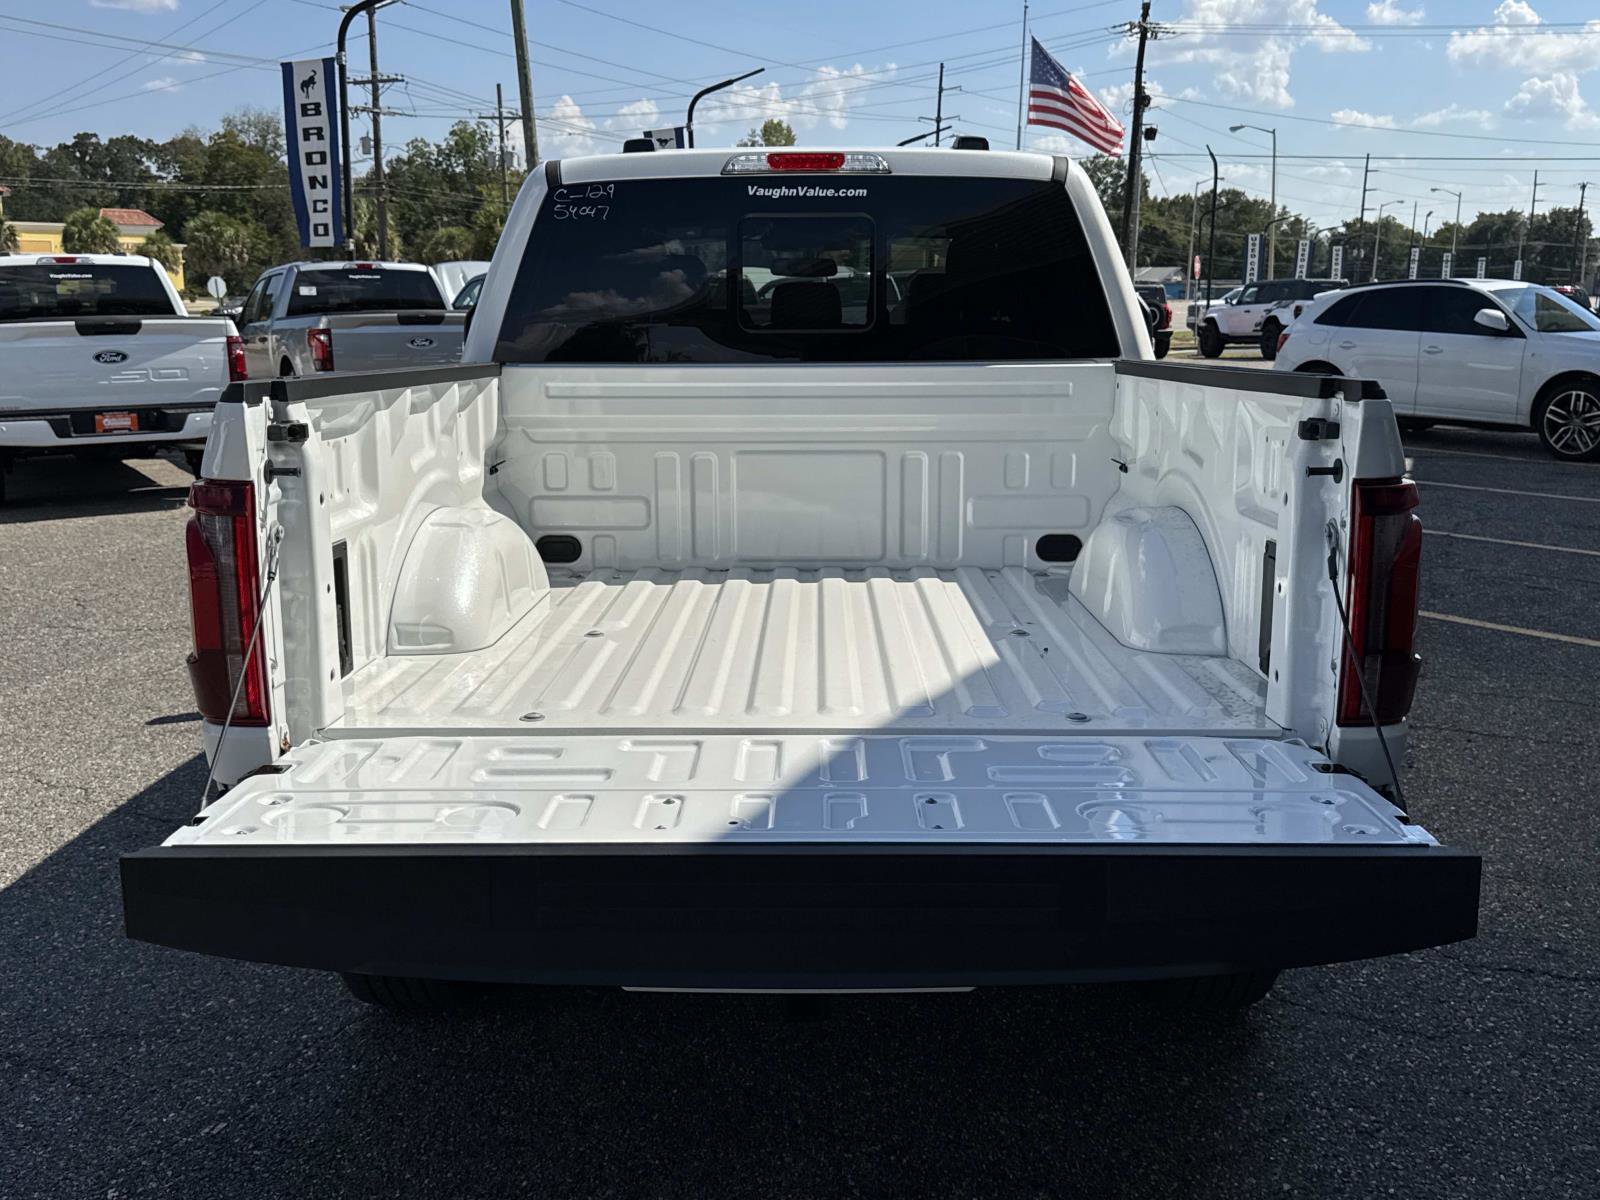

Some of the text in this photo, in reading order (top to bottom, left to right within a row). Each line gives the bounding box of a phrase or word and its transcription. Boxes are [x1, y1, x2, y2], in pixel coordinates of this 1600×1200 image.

[300, 102, 330, 237] BRONCO
[554, 184, 614, 202] C-129
[747, 185, 867, 199] VaughnValue.com
[554, 204, 611, 221] 54047
